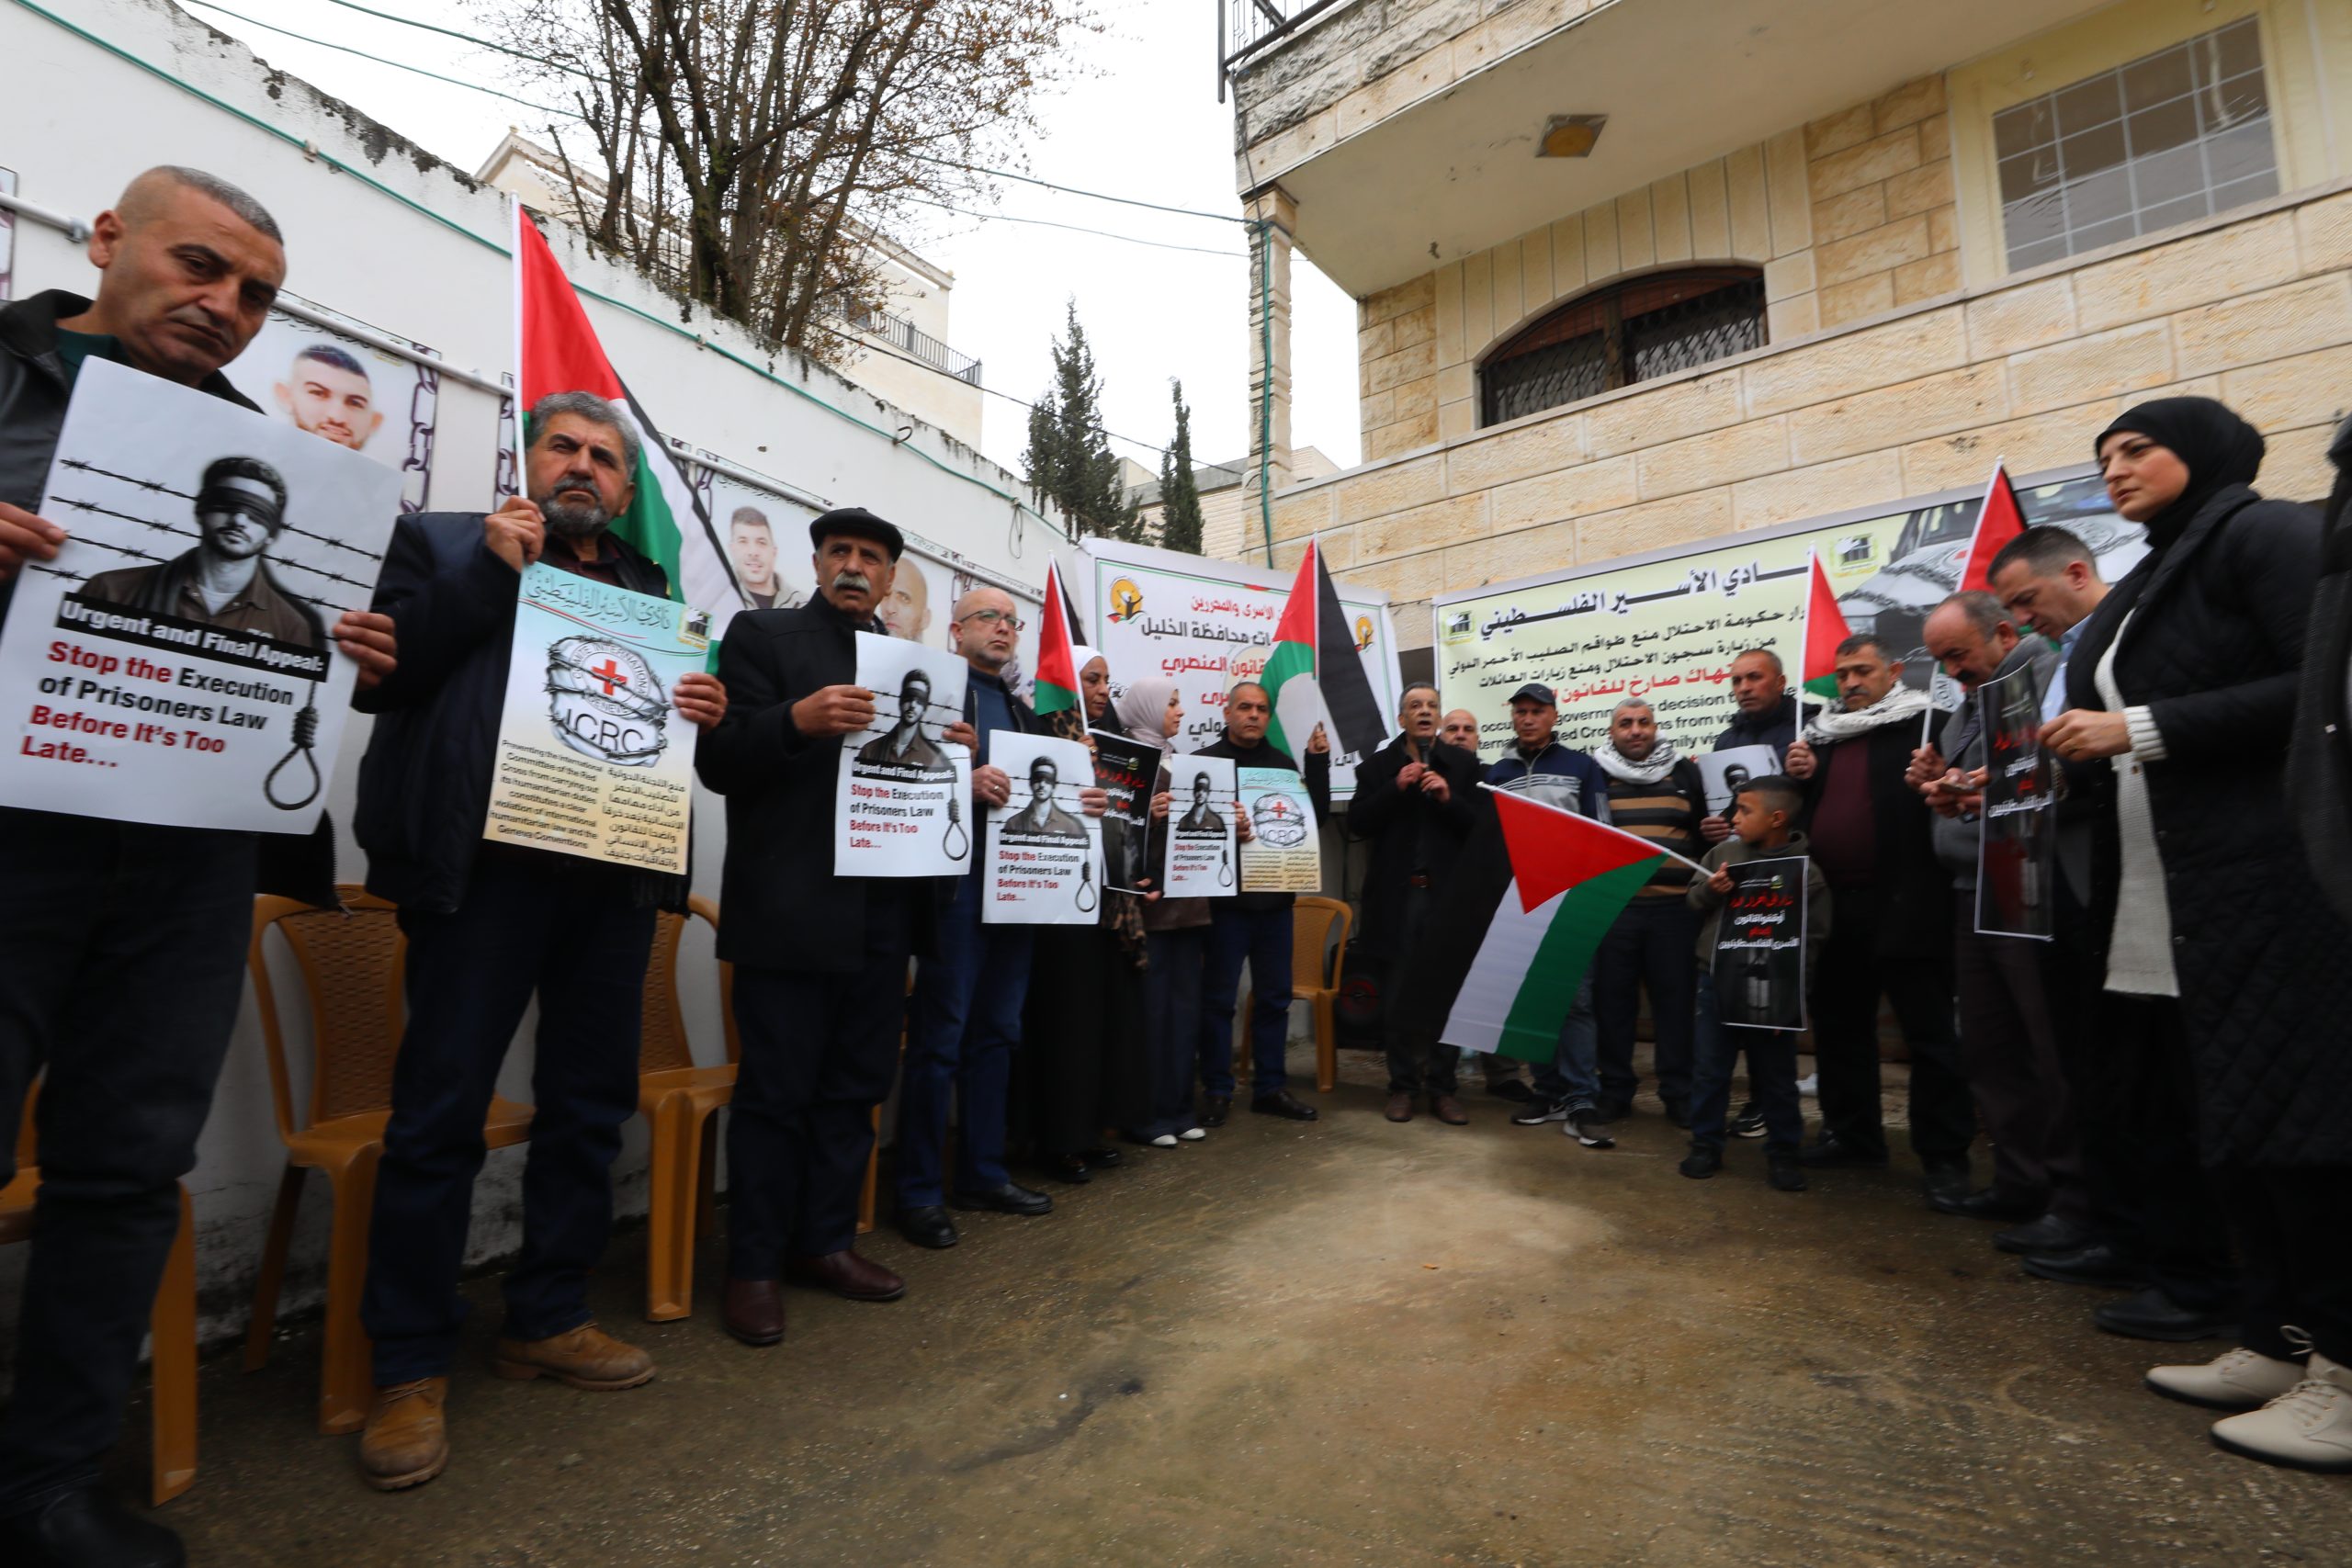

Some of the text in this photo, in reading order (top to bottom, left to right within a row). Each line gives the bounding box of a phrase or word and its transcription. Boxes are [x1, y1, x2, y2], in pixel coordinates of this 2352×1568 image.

[1480, 560, 1809, 641] ادي الأسير الفلسطيني
[1140, 616, 1187, 640] الخليل
[1724, 609, 1784, 627] حكومة
[60, 599, 324, 672] Urgent and Final Appeal:
[1192, 620, 1250, 644] محافظة
[1631, 629, 1660, 648] منع
[1663, 618, 1721, 641] الاحتلال
[1526, 642, 1578, 662] الصليب
[1581, 635, 1625, 654] طواقم
[1661, 643, 1713, 664] سجون
[1717, 637, 1751, 656] زيارة
[1161, 654, 1227, 677] العنصري
[1448, 657, 1480, 679] الدولي
[1481, 647, 1524, 670] الأحمر
[1602, 651, 1659, 673] الاحتلال
[48, 640, 294, 705] Stop the Execution
[1479, 672, 1527, 688] العائلات
[1530, 668, 1566, 681] زيارات
[1568, 661, 1600, 680] ومنع
[1562, 679, 1625, 704] للقانون
[1629, 673, 1681, 698] صارخ
[39, 675, 269, 730] of Prisoners Law
[1658, 694, 1725, 713] decision
[29, 705, 227, 753] Before It's Too
[566, 708, 644, 753] ICRC
[1675, 715, 1713, 728] from
[20, 736, 119, 768] Late...
[507, 752, 556, 771] Committee
[565, 768, 580, 776] the
[853, 761, 955, 782] Urgent and Final Appeal:
[501, 762, 527, 775] Cross
[529, 770, 549, 781] from
[551, 776, 585, 791] carrying
[509, 791, 559, 807] constitutes
[514, 779, 571, 797] humanitarian
[571, 792, 597, 804] duties
[851, 784, 944, 801] Stop the Execution
[850, 802, 934, 817] of Prisoners Law
[488, 810, 549, 829] humanitarian
[568, 828, 583, 837] and
[584, 831, 598, 840] the
[850, 819, 881, 833] Before
[899, 823, 919, 833] Too
[497, 824, 589, 850] Geneva Conventions
[999, 850, 1080, 863] Stop the Execution
[998, 864, 1072, 875] of Prisoners Law
[998, 878, 1027, 888] Before
[1043, 880, 1059, 889] Too
